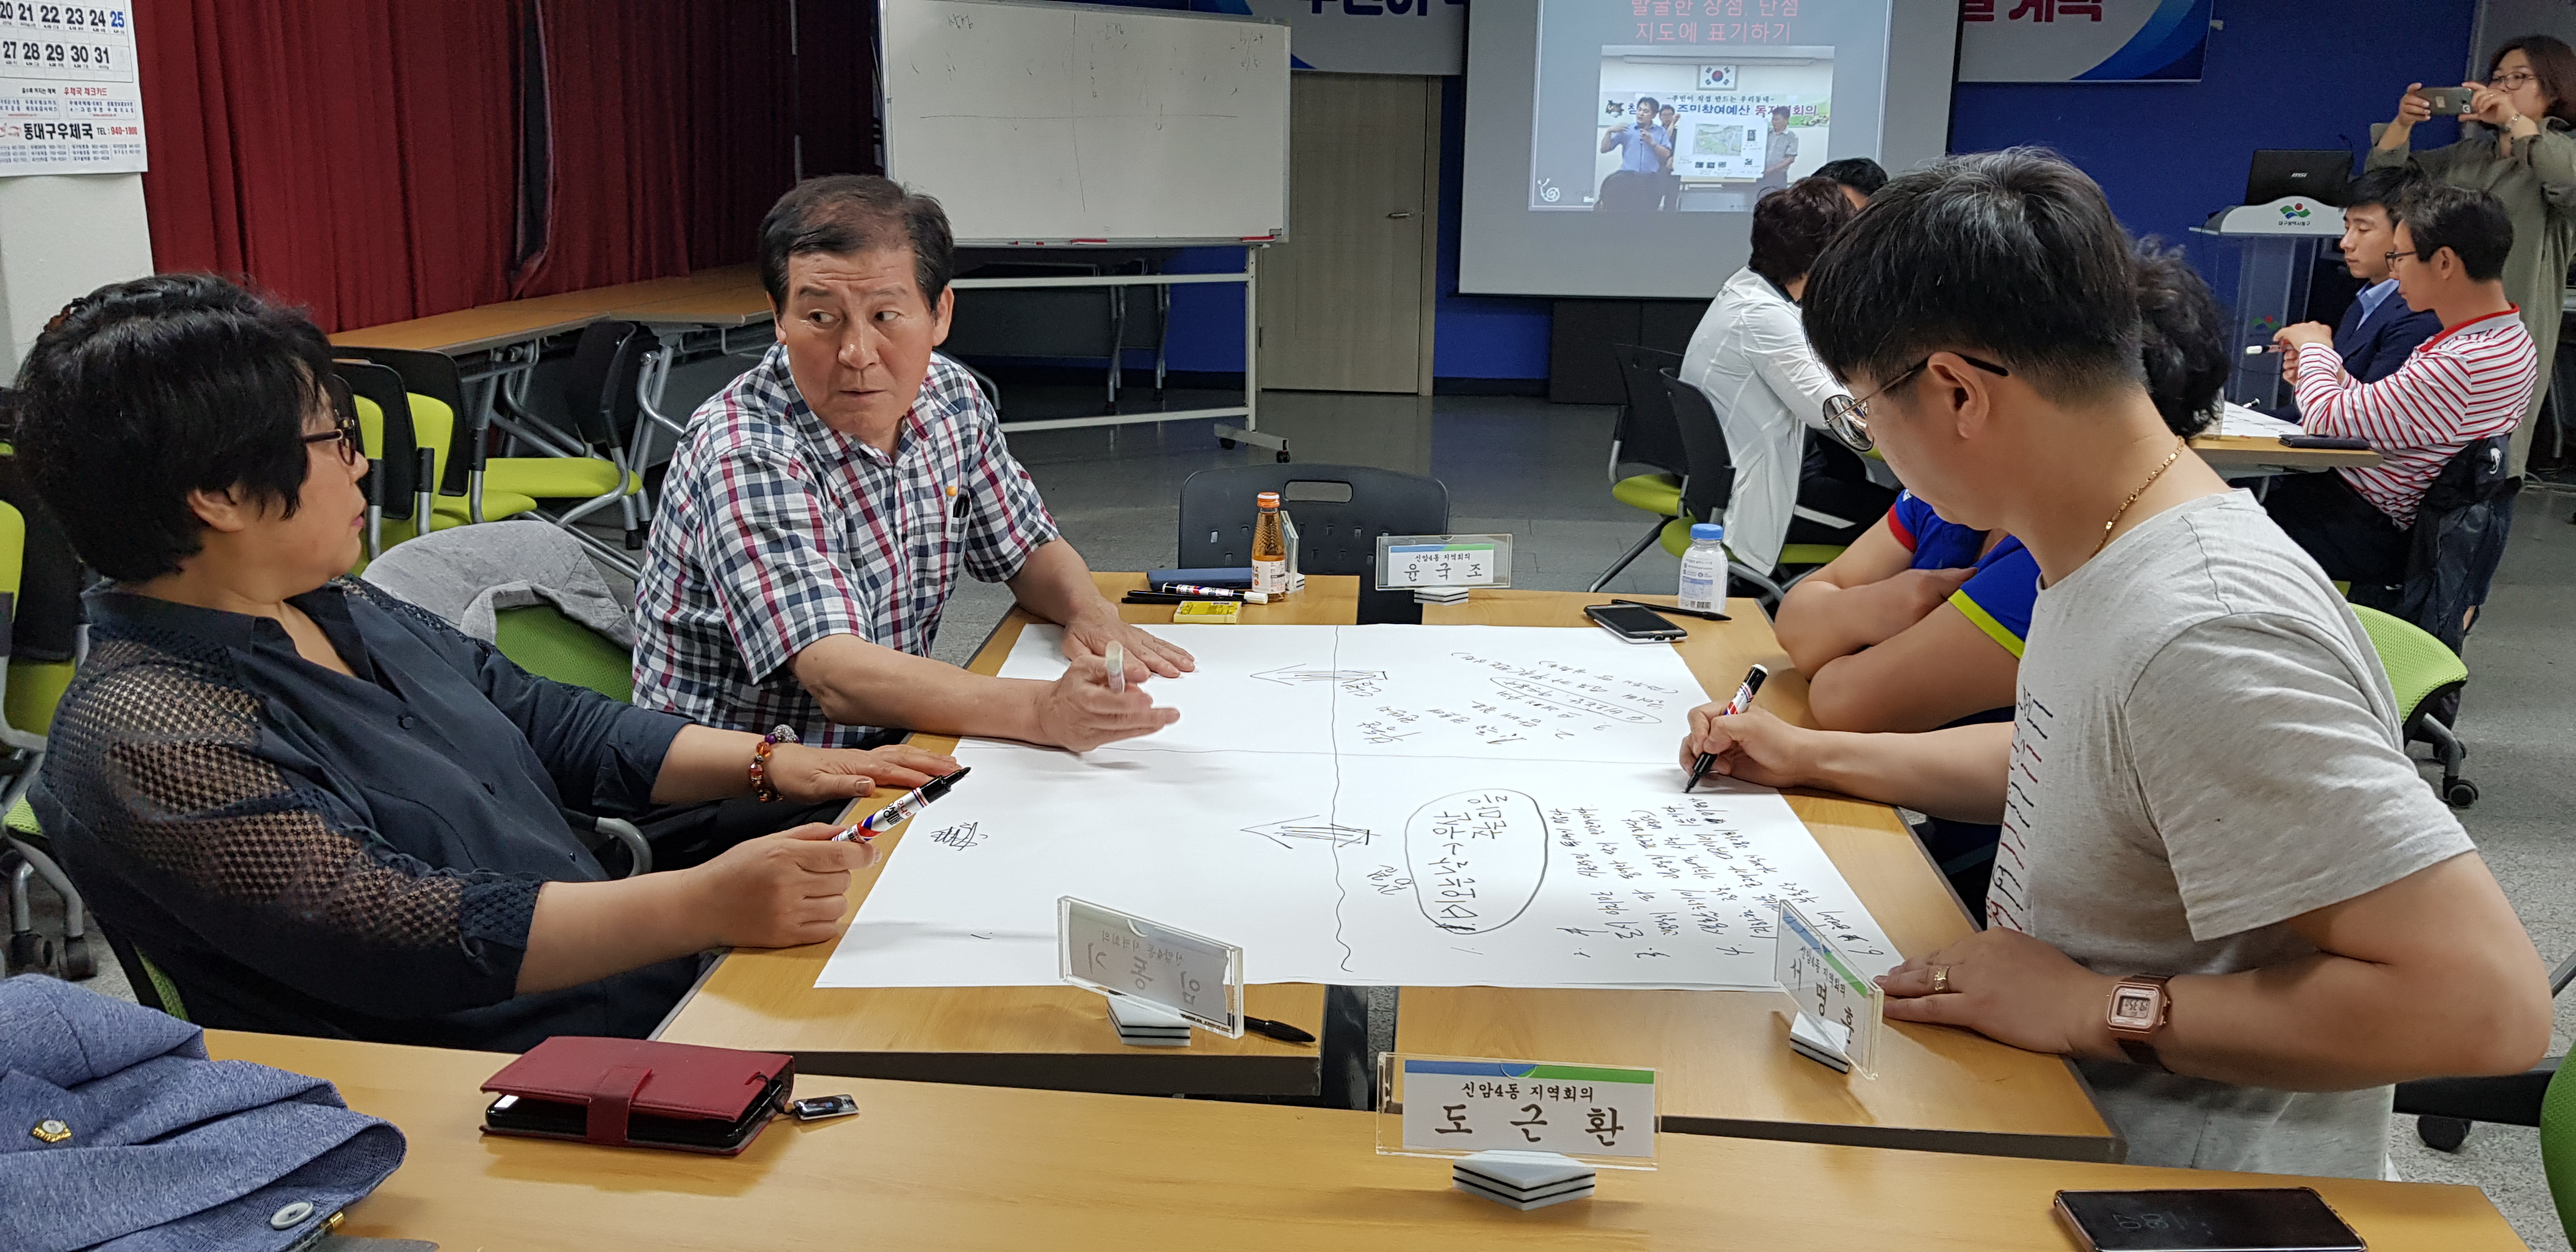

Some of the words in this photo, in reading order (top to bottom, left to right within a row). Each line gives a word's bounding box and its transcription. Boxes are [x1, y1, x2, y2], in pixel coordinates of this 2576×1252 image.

[0, 1, 13, 20] 20
[19, 3, 34, 22] 21
[40, 5, 61, 24] 22
[66, 7, 84, 26] 23
[89, 9, 106, 27] 24
[110, 11, 125, 27] 25
[1636, 22, 1698, 43] 지도에
[1707, 22, 1791, 43] 표기하기
[3, 41, 17, 59] 27
[23, 42, 40, 60] 28
[45, 43, 64, 61] 29
[71, 45, 89, 63] 30
[95, 47, 110, 64] 31
[64, 87, 82, 96] 우체국
[84, 87, 107, 96] 체크카드
[24, 123, 93, 140] 동대구우체국
[1415, 553, 1439, 562] 신암4동
[1444, 553, 1471, 561] 지역회의
[1404, 563, 1420, 582] 윤
[1436, 562, 1452, 581] 국
[1466, 563, 1482, 577] 조
[1432, 811, 1471, 840] 우산
[1427, 857, 1479, 919] 비오는날
[1461, 1081, 1520, 1101] 신암4동
[1529, 1084, 1594, 1103] 지역회의
[1434, 1103, 1473, 1134] 도
[1510, 1103, 1548, 1142] 근
[1584, 1106, 1625, 1147] 환
